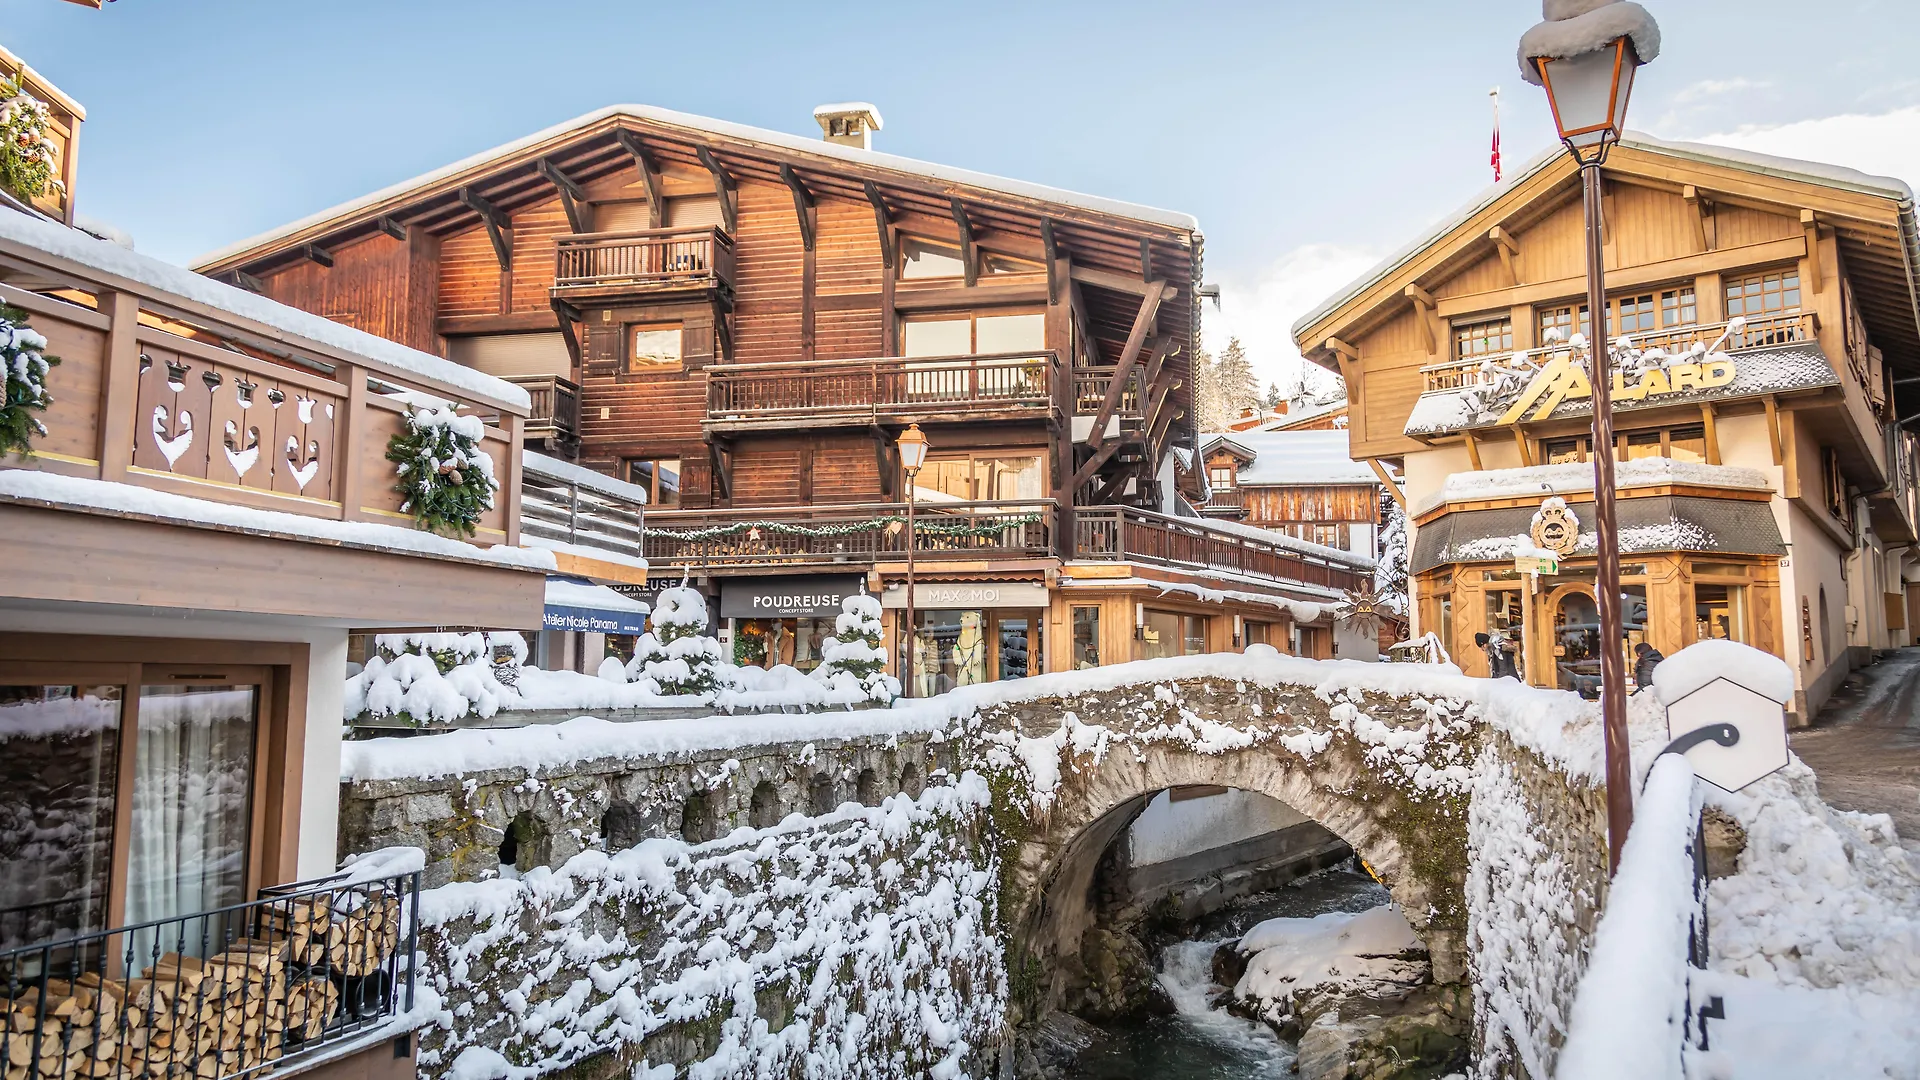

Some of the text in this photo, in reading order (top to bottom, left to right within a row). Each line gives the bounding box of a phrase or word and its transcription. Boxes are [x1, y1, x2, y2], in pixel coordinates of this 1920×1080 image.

[753, 594, 840, 608] POUDREUSE
[567, 615, 589, 628] Nicole
[590, 616, 618, 630] Panama
